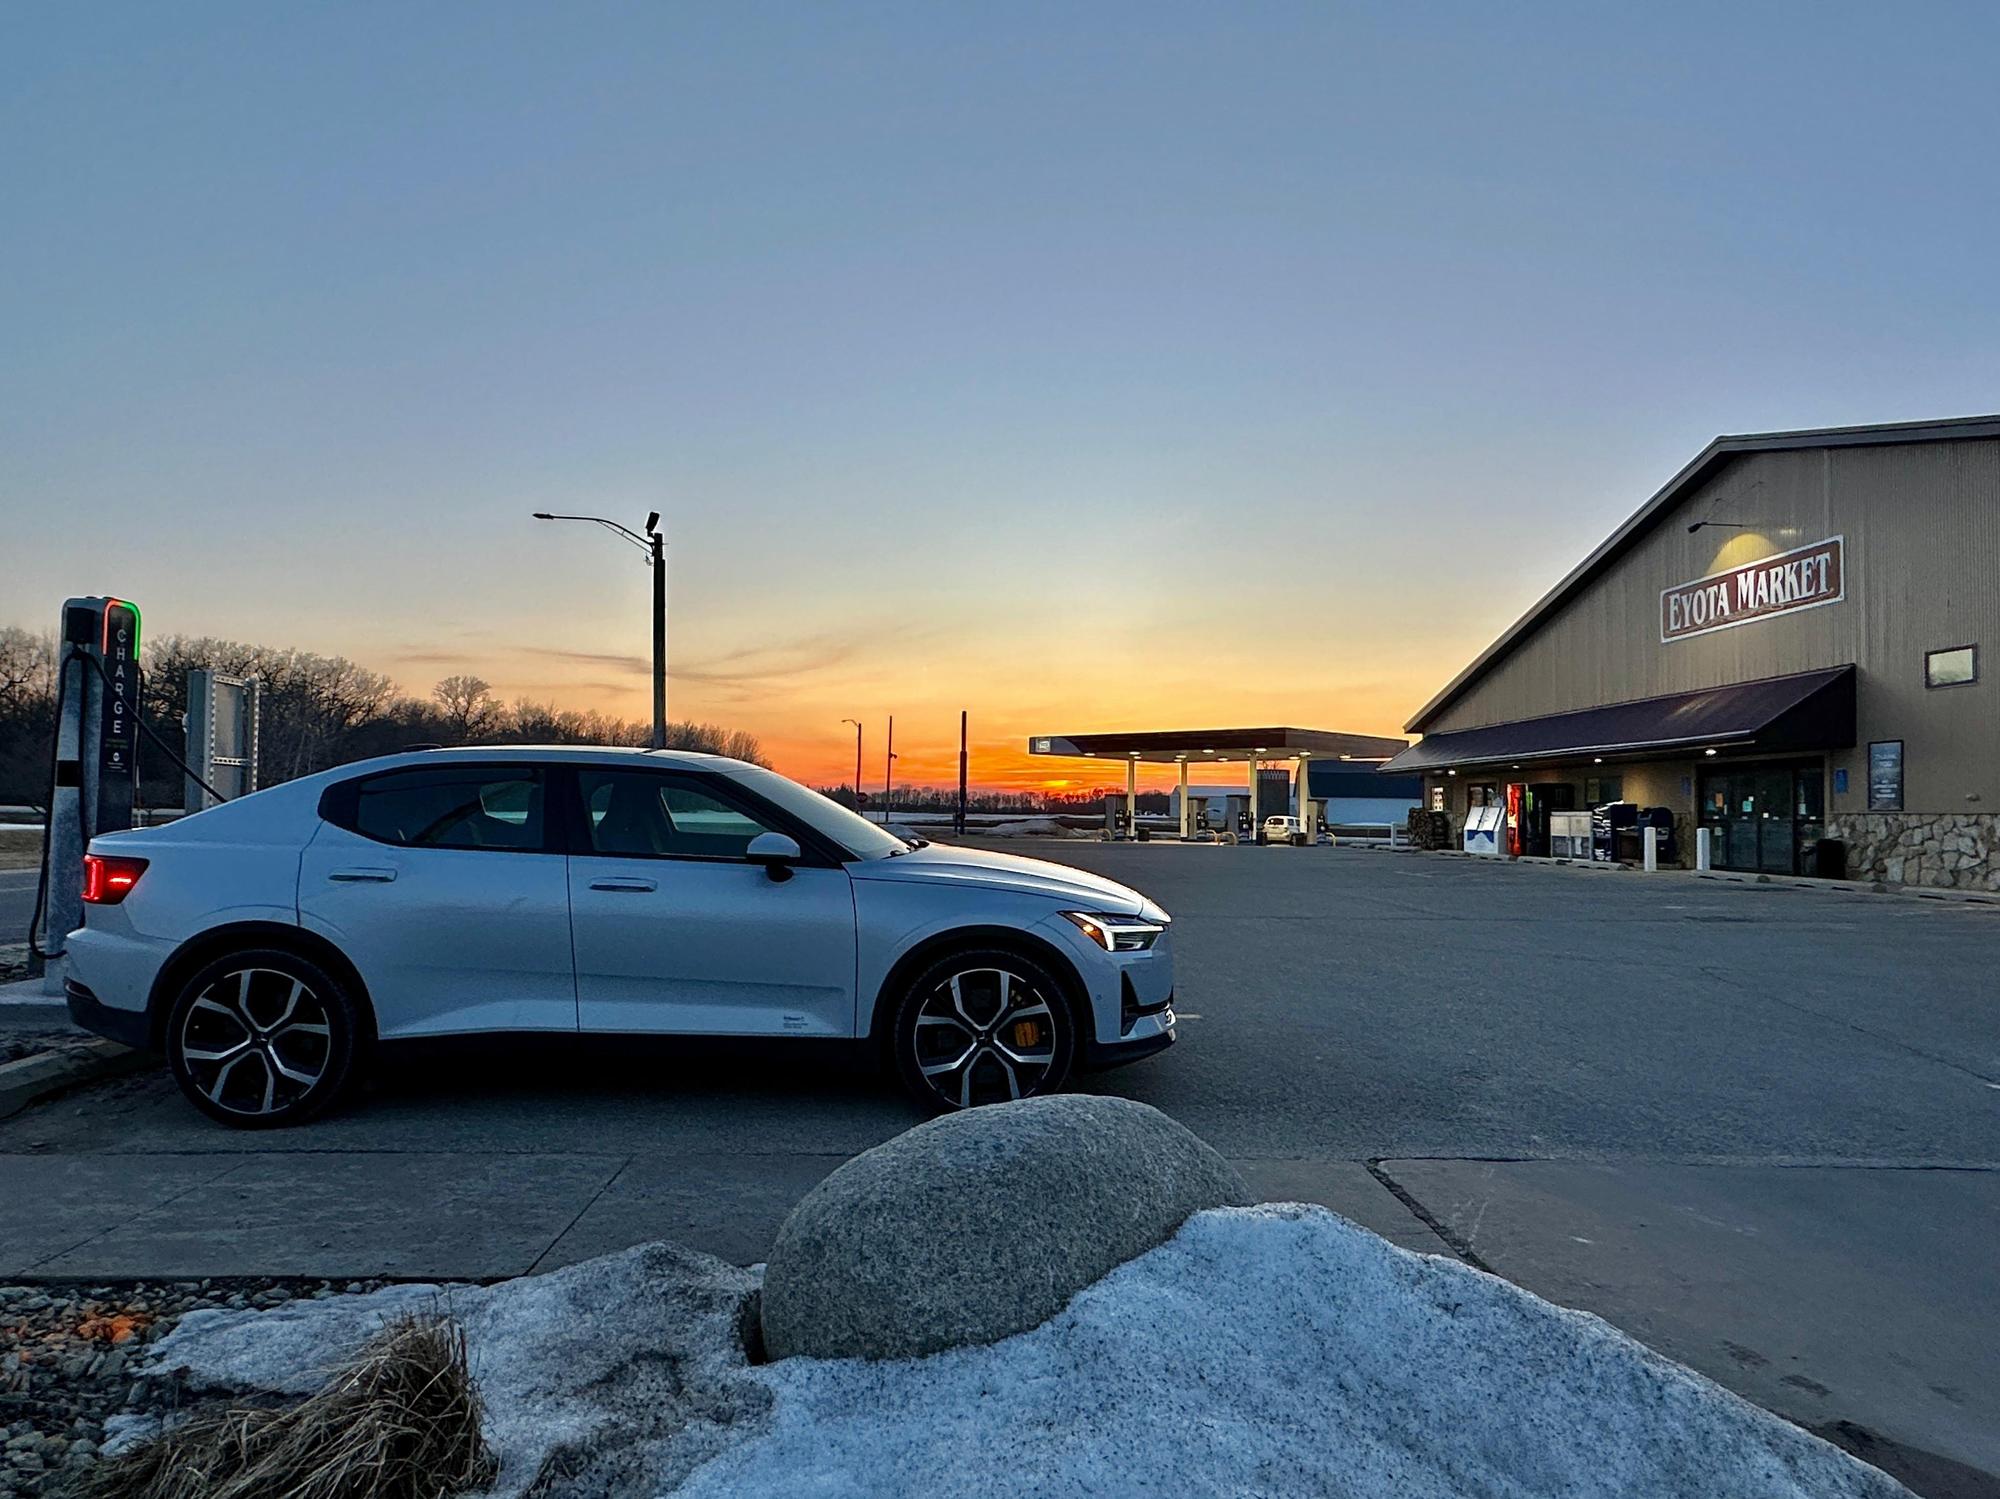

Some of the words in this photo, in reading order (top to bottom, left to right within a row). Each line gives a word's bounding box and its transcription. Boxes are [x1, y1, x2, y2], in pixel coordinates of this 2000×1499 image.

[1669, 582, 1730, 631] EYOTA
[1736, 552, 1831, 610] MARKET
[113, 629, 127, 733] CHARGE
